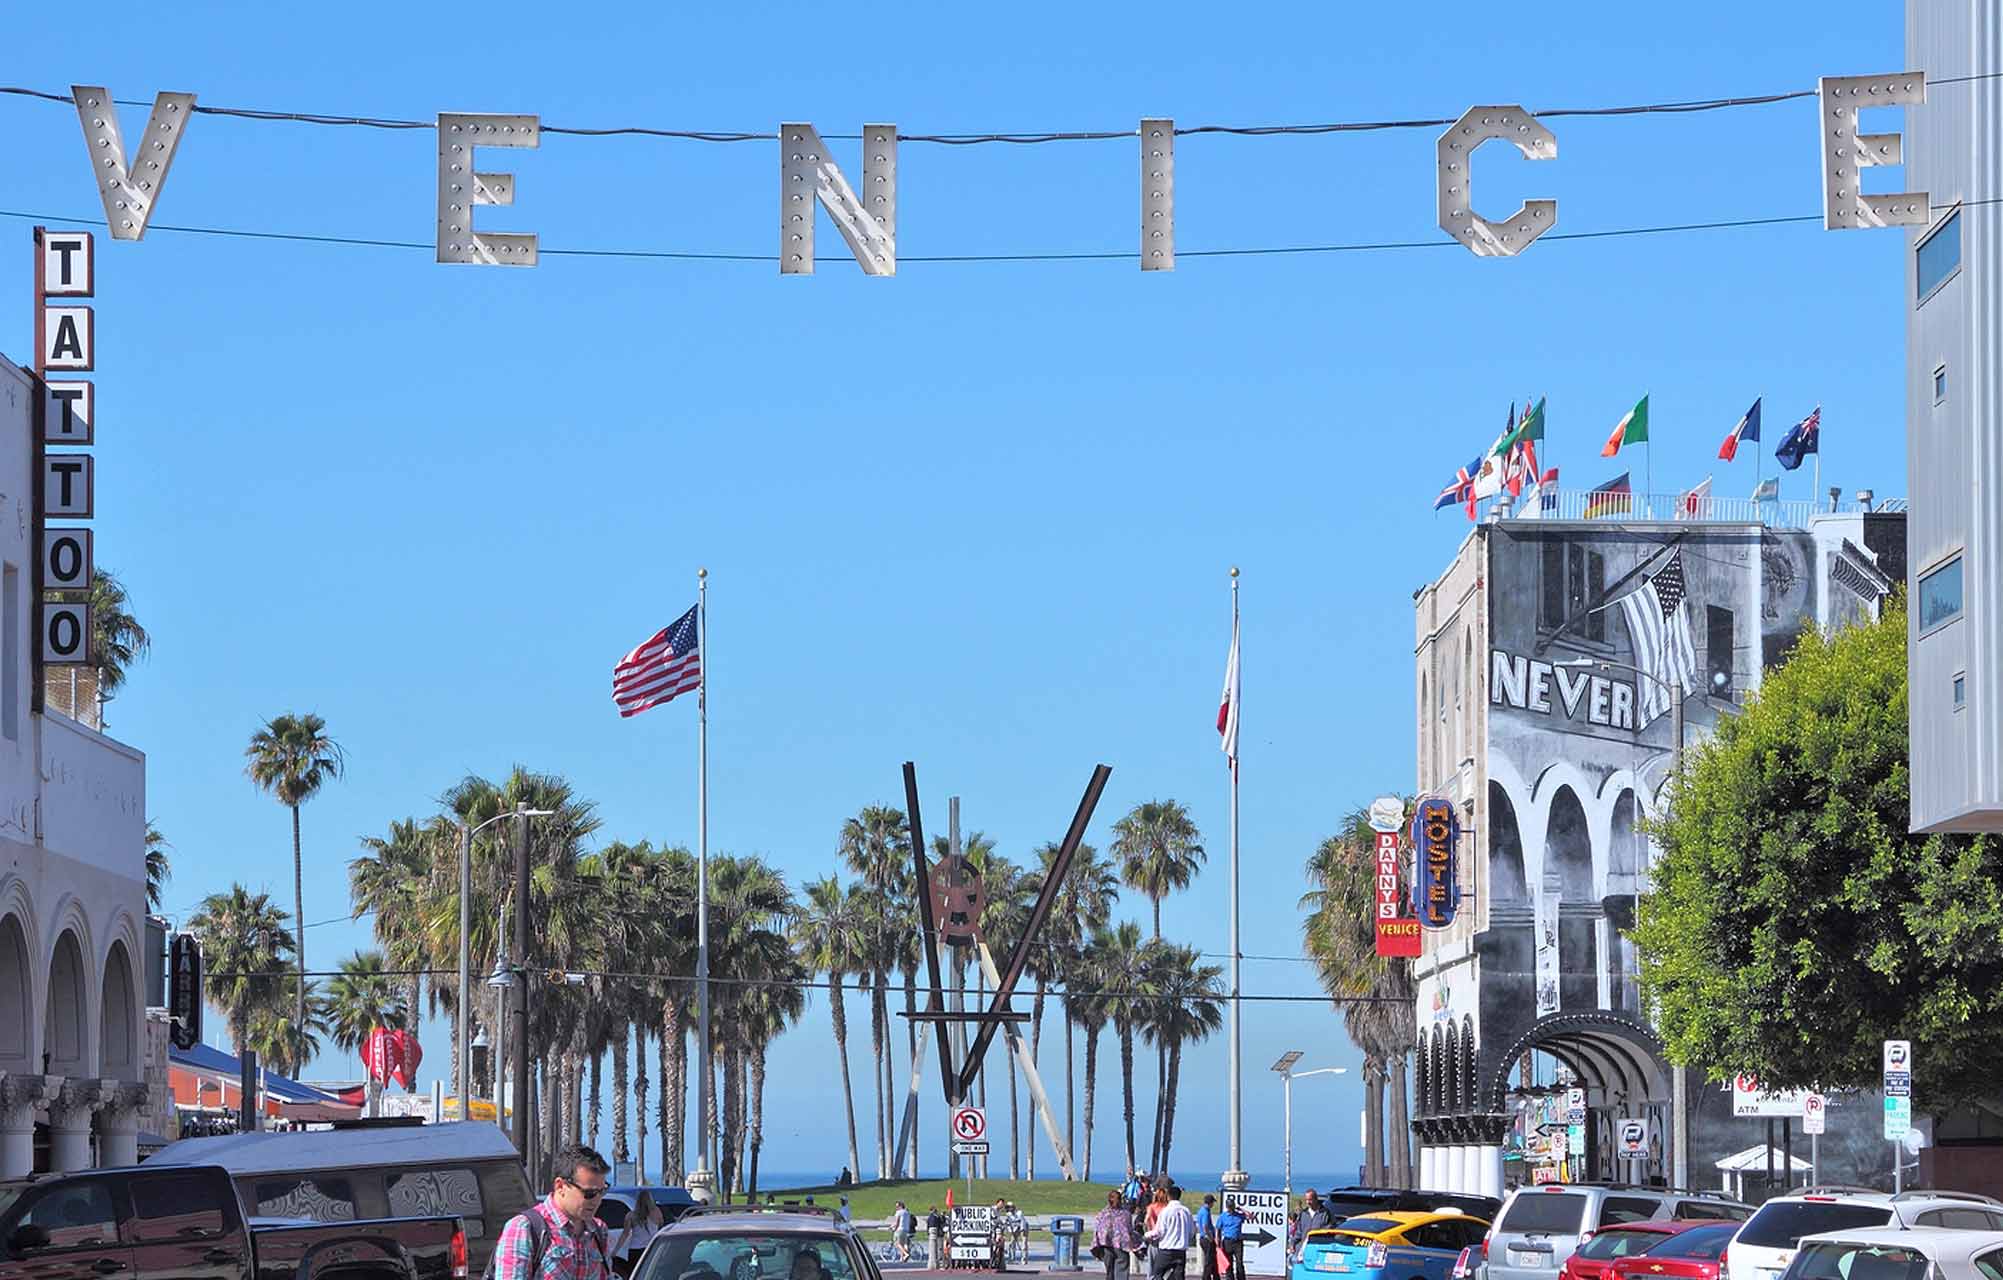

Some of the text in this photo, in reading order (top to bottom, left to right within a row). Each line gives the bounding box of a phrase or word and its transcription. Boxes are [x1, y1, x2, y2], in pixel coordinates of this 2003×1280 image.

[71, 72, 1930, 277] VENICE
[49, 241, 83, 656] TATTOO
[1492, 650, 1634, 731] NEVER
[1380, 835, 1395, 917] DANNYS
[1425, 805, 1449, 922] HOSTEL
[1379, 923, 1418, 935] VENICE
[1737, 1105, 1759, 1114] ATM
[955, 1208, 987, 1219] PUBLIC
[1227, 1194, 1283, 1208] PUBLIC
[952, 1220, 989, 1232] PARKING
